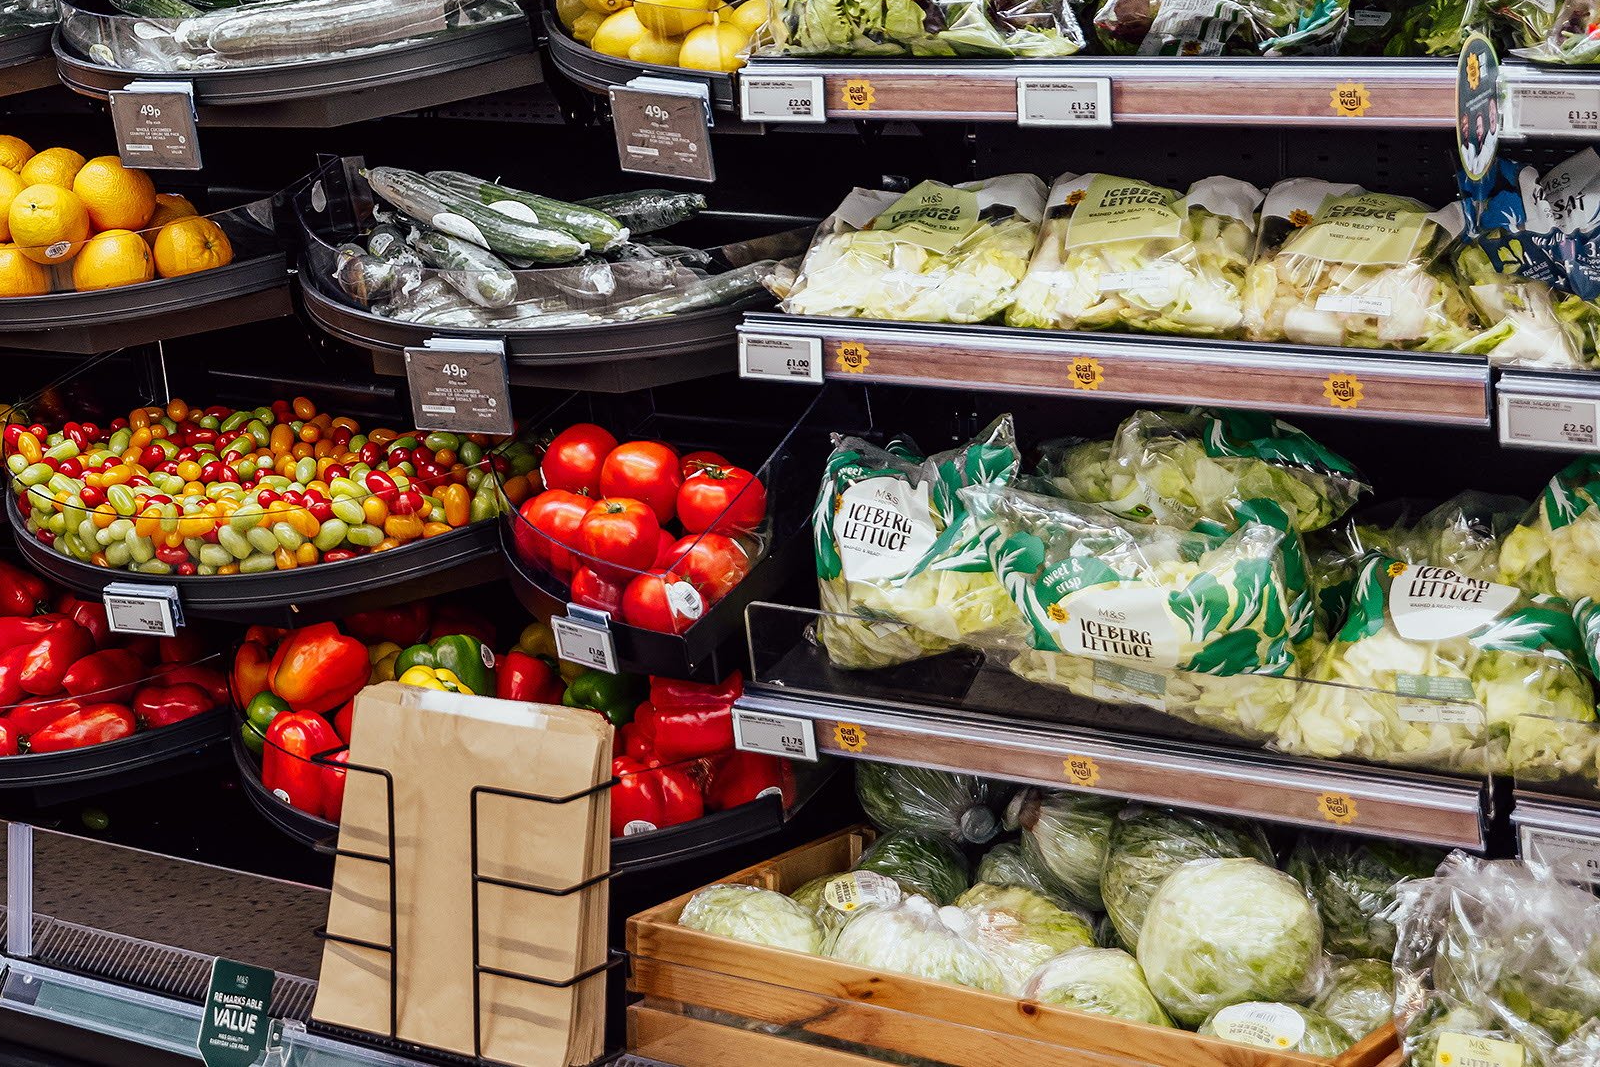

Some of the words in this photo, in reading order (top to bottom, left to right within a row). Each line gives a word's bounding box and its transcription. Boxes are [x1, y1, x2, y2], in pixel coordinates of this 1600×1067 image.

[849, 85, 864, 94] eat
[1339, 88, 1357, 98] eat
[849, 92, 868, 101] well
[1339, 96, 1361, 106] well
[789, 99, 811, 107] £2.00
[1071, 102, 1096, 110] £1.35
[140, 104, 161, 117] 49p
[644, 105, 669, 120] 49p
[1568, 111, 1598, 120] £1.35
[921, 193, 943, 204] M&S
[1099, 195, 1167, 207] LETTUCE
[1359, 197, 1388, 207] M&S
[843, 347, 859, 356] eat
[787, 359, 809, 367] £1.00
[843, 354, 862, 364] well
[442, 364, 468, 377] 49p
[1075, 363, 1092, 372] eat
[1075, 370, 1096, 380] well
[1332, 379, 1350, 389] eat
[1332, 387, 1355, 398] well
[1563, 424, 1593, 433] £2.50
[875, 489, 900, 505] M&S
[848, 503, 913, 535] ICEBERG
[843, 521, 911, 552] LETTUCE
[1043, 562, 1068, 588] sweet
[1071, 557, 1084, 572] &
[1055, 576, 1082, 594] crisp
[1409, 580, 1488, 603] LETTUCE
[1097, 607, 1126, 621] M&S
[1080, 617, 1153, 647] ICEBERG
[1080, 631, 1155, 659] LETTUCE
[841, 727, 856, 735] eat
[781, 736, 803, 746] £1.75
[841, 734, 860, 743] well
[1071, 760, 1089, 769] eat
[1071, 767, 1092, 777] well
[1325, 796, 1344, 805] eat
[1326, 803, 1349, 814] well
[236, 975, 249, 984] M&S
[213, 1006, 258, 1034] VALUE
